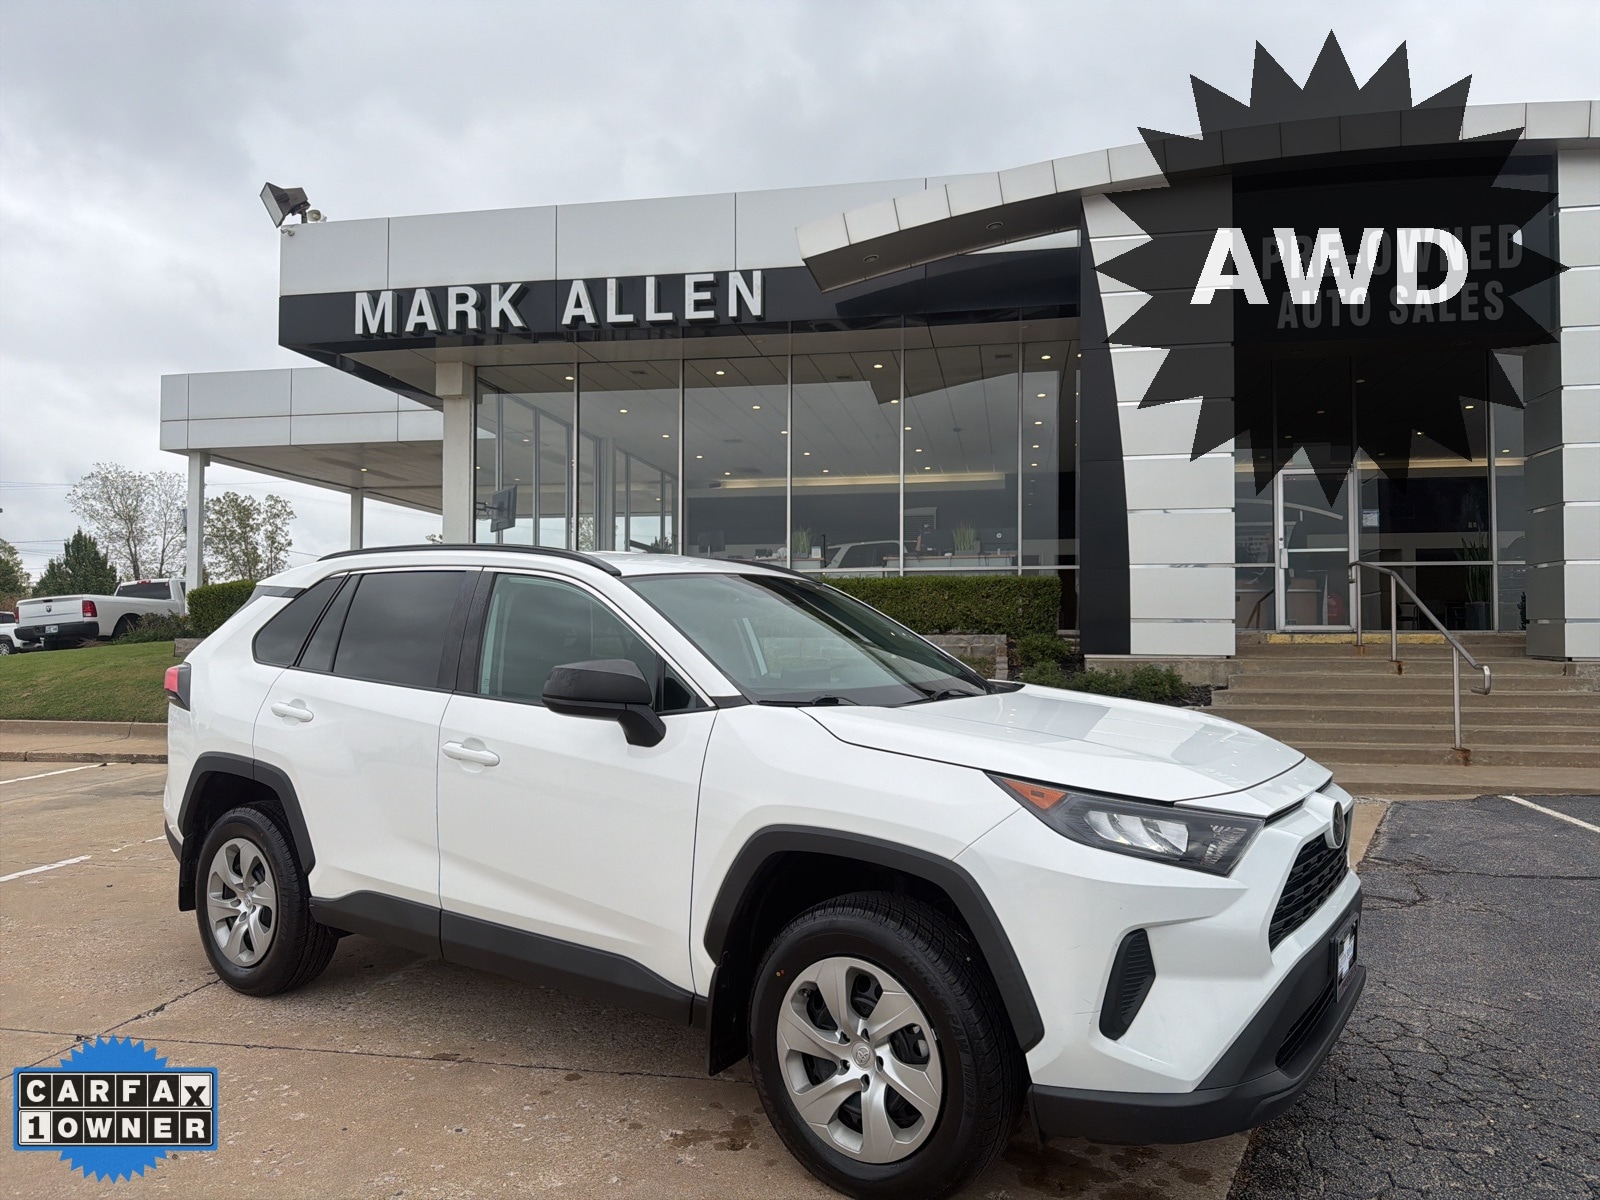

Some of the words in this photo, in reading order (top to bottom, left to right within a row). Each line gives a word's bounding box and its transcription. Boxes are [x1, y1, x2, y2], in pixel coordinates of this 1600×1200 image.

[1261, 223, 1523, 281] PRE-OWNED
[354, 283, 526, 336] MARK
[561, 270, 764, 326] ALLEN
[1276, 287, 1372, 329] AUTO
[1388, 280, 1505, 326] SALES
